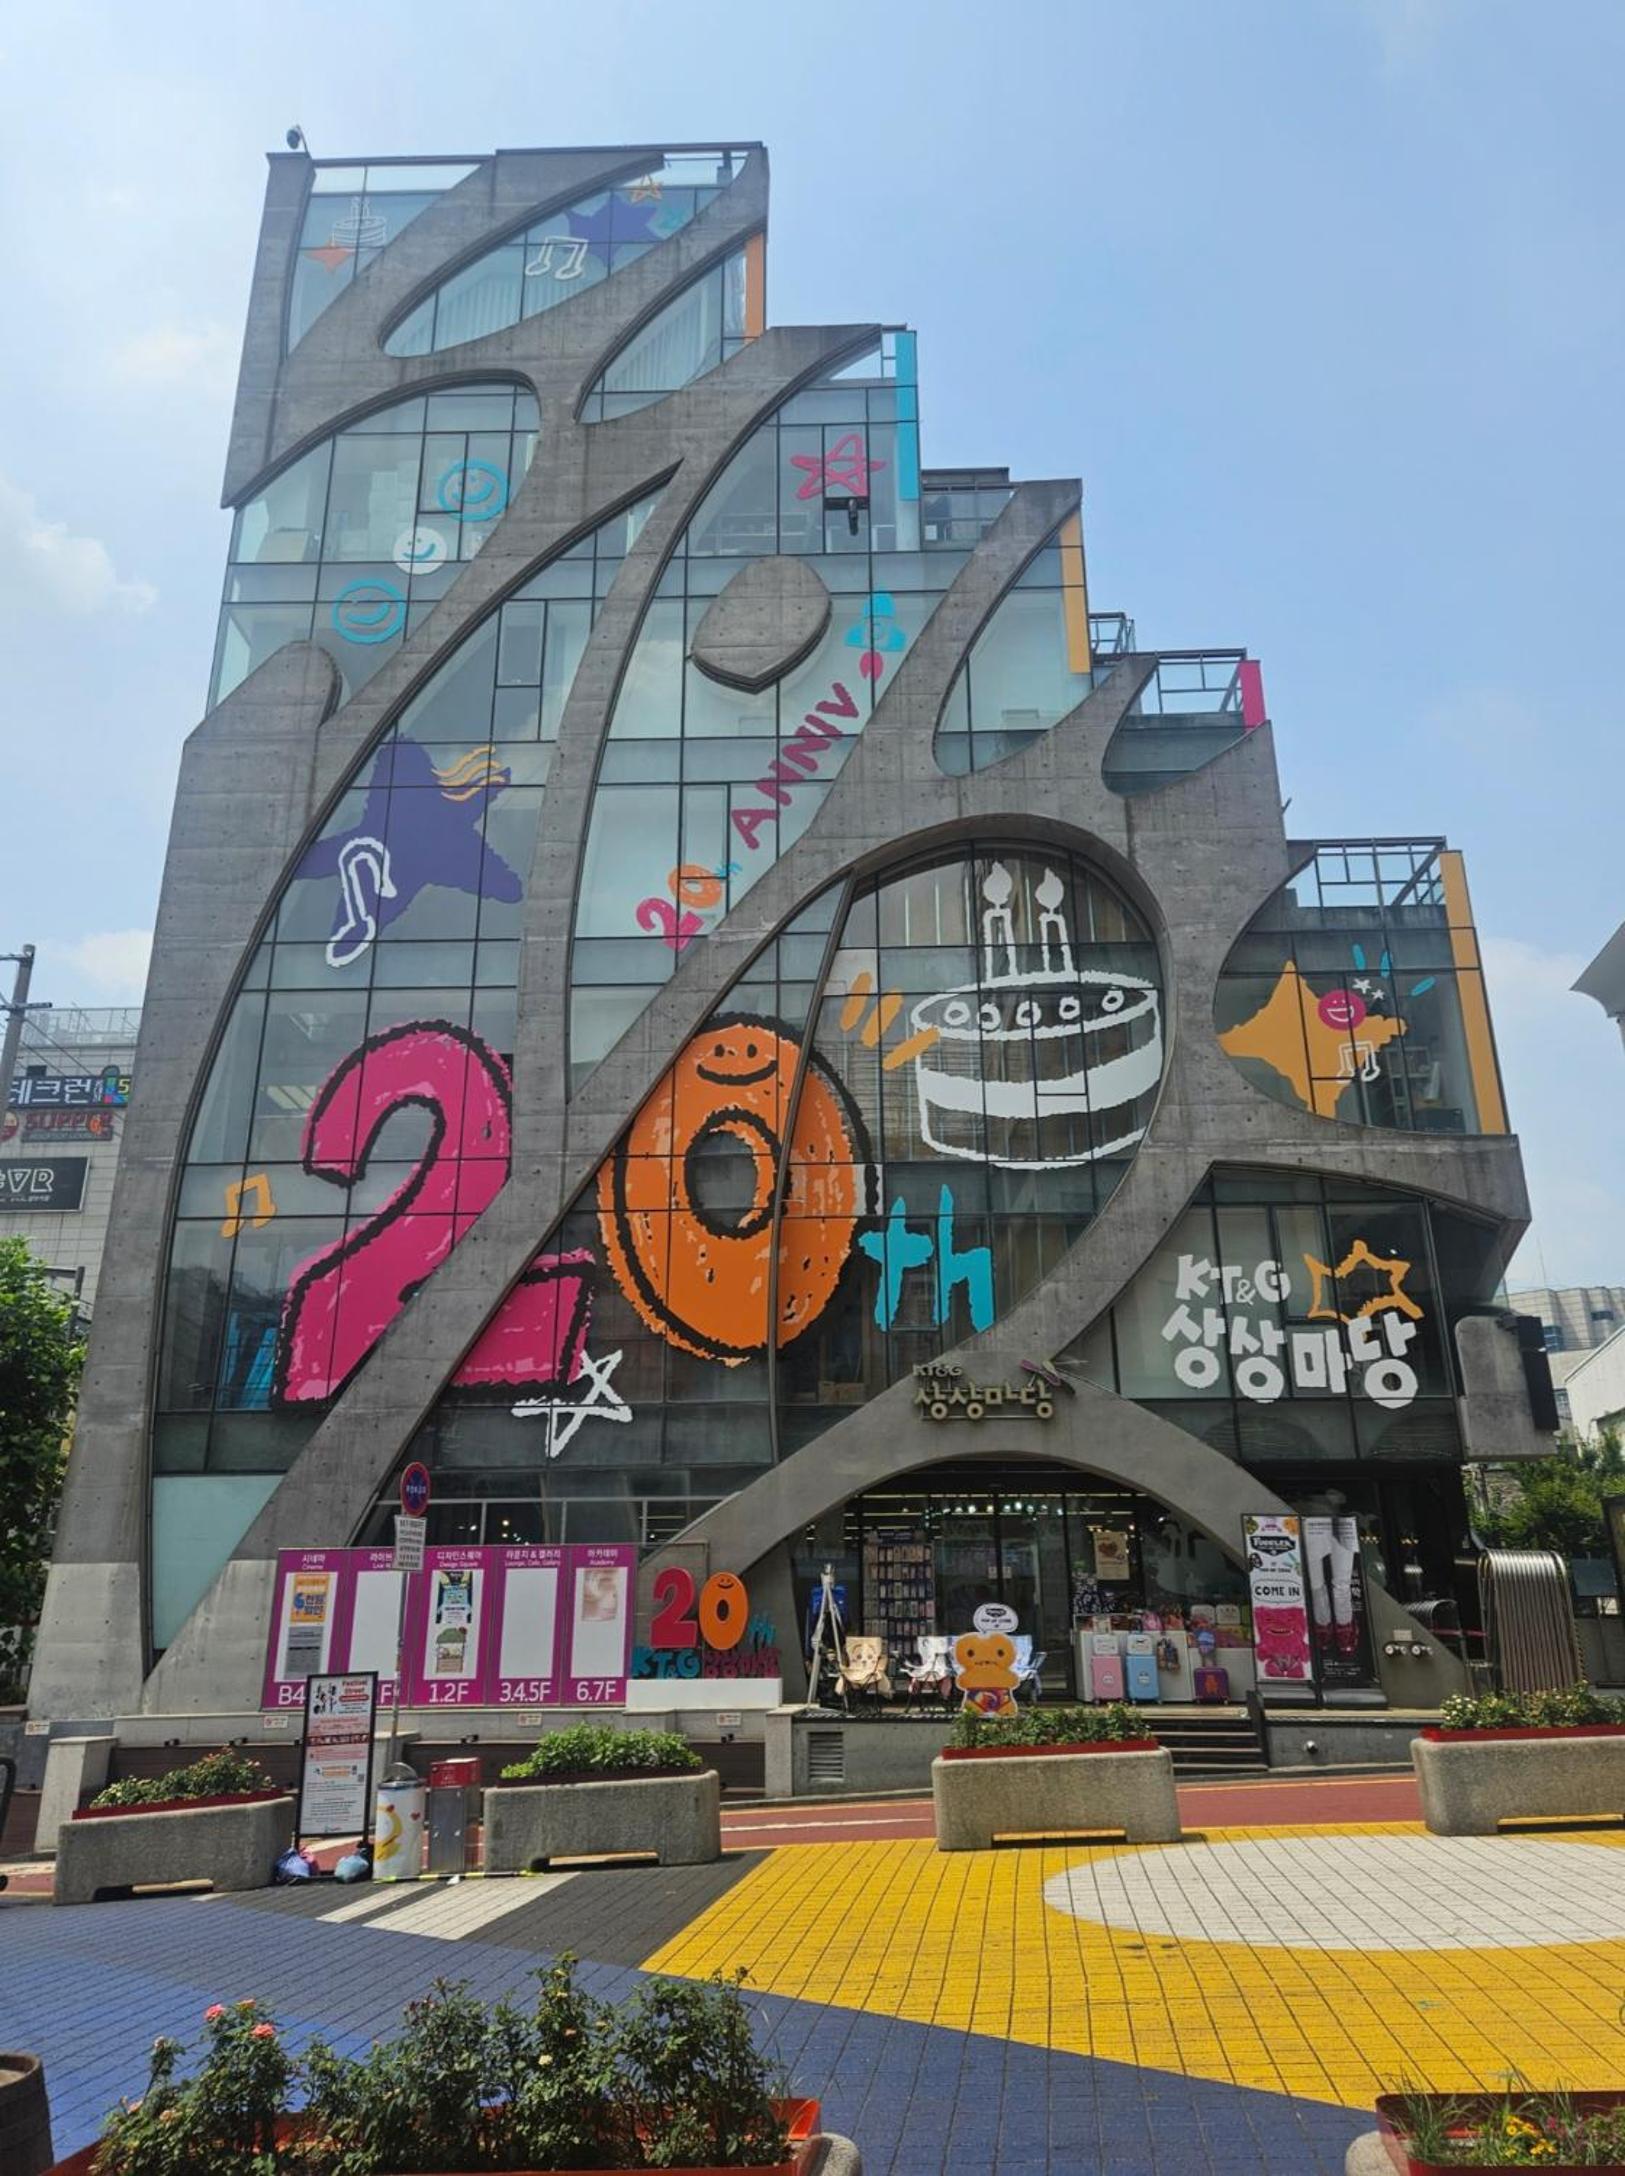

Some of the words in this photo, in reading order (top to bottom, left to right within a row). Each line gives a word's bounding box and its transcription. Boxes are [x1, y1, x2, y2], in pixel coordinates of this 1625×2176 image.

[1175, 1254, 1291, 1305] KT&G
[1161, 1303, 1419, 1409] 상상마당
[912, 1363, 963, 1377] KT&G
[914, 1379, 1053, 1420] 상상마당
[1254, 1586, 1285, 1597] COME
[1288, 1586, 1300, 1597] IN
[428, 1682, 469, 1702] 1.2F
[500, 1682, 551, 1702] 3.4.5F
[576, 1681, 616, 1701] 6.7F
